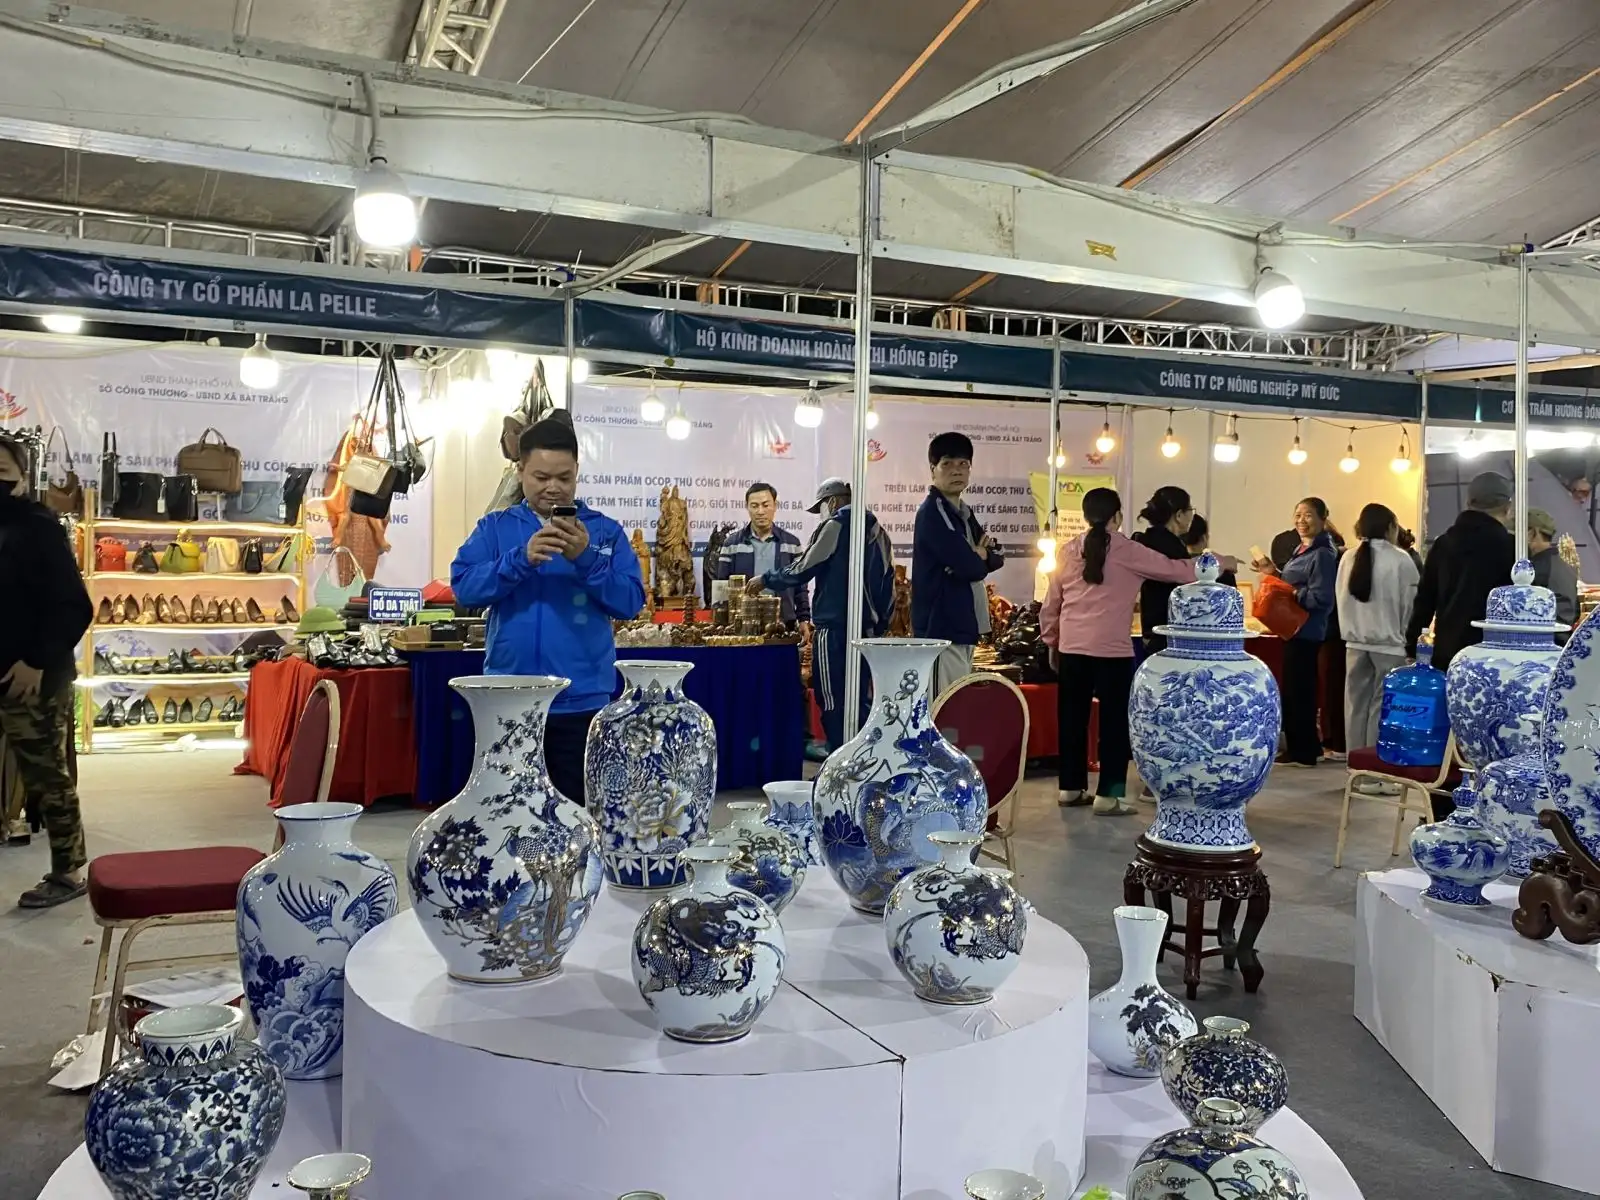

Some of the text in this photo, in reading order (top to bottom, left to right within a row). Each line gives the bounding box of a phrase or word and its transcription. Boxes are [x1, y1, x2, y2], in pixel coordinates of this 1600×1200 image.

[93, 270, 154, 298] CÔNG
[161, 279, 186, 300] TY
[289, 291, 313, 312] LA
[320, 293, 377, 317] PELLE
[696, 328, 717, 347] HỘ
[721, 330, 758, 351] KINH
[870, 346, 886, 368] HỊ
[929, 349, 959, 373] ĐIỆP
[115, 384, 146, 396] CÔNG
[148, 387, 188, 399] THƯƠNG
[196, 391, 221, 400] UBND
[1159, 369, 1341, 401] CÔNG TY CP NÔNG NGHIỆP MỸ ĐỨC
[966, 483, 984, 494] HẨM
[985, 486, 1008, 496] OCOP,
[1021, 524, 1039, 533] GIAN
